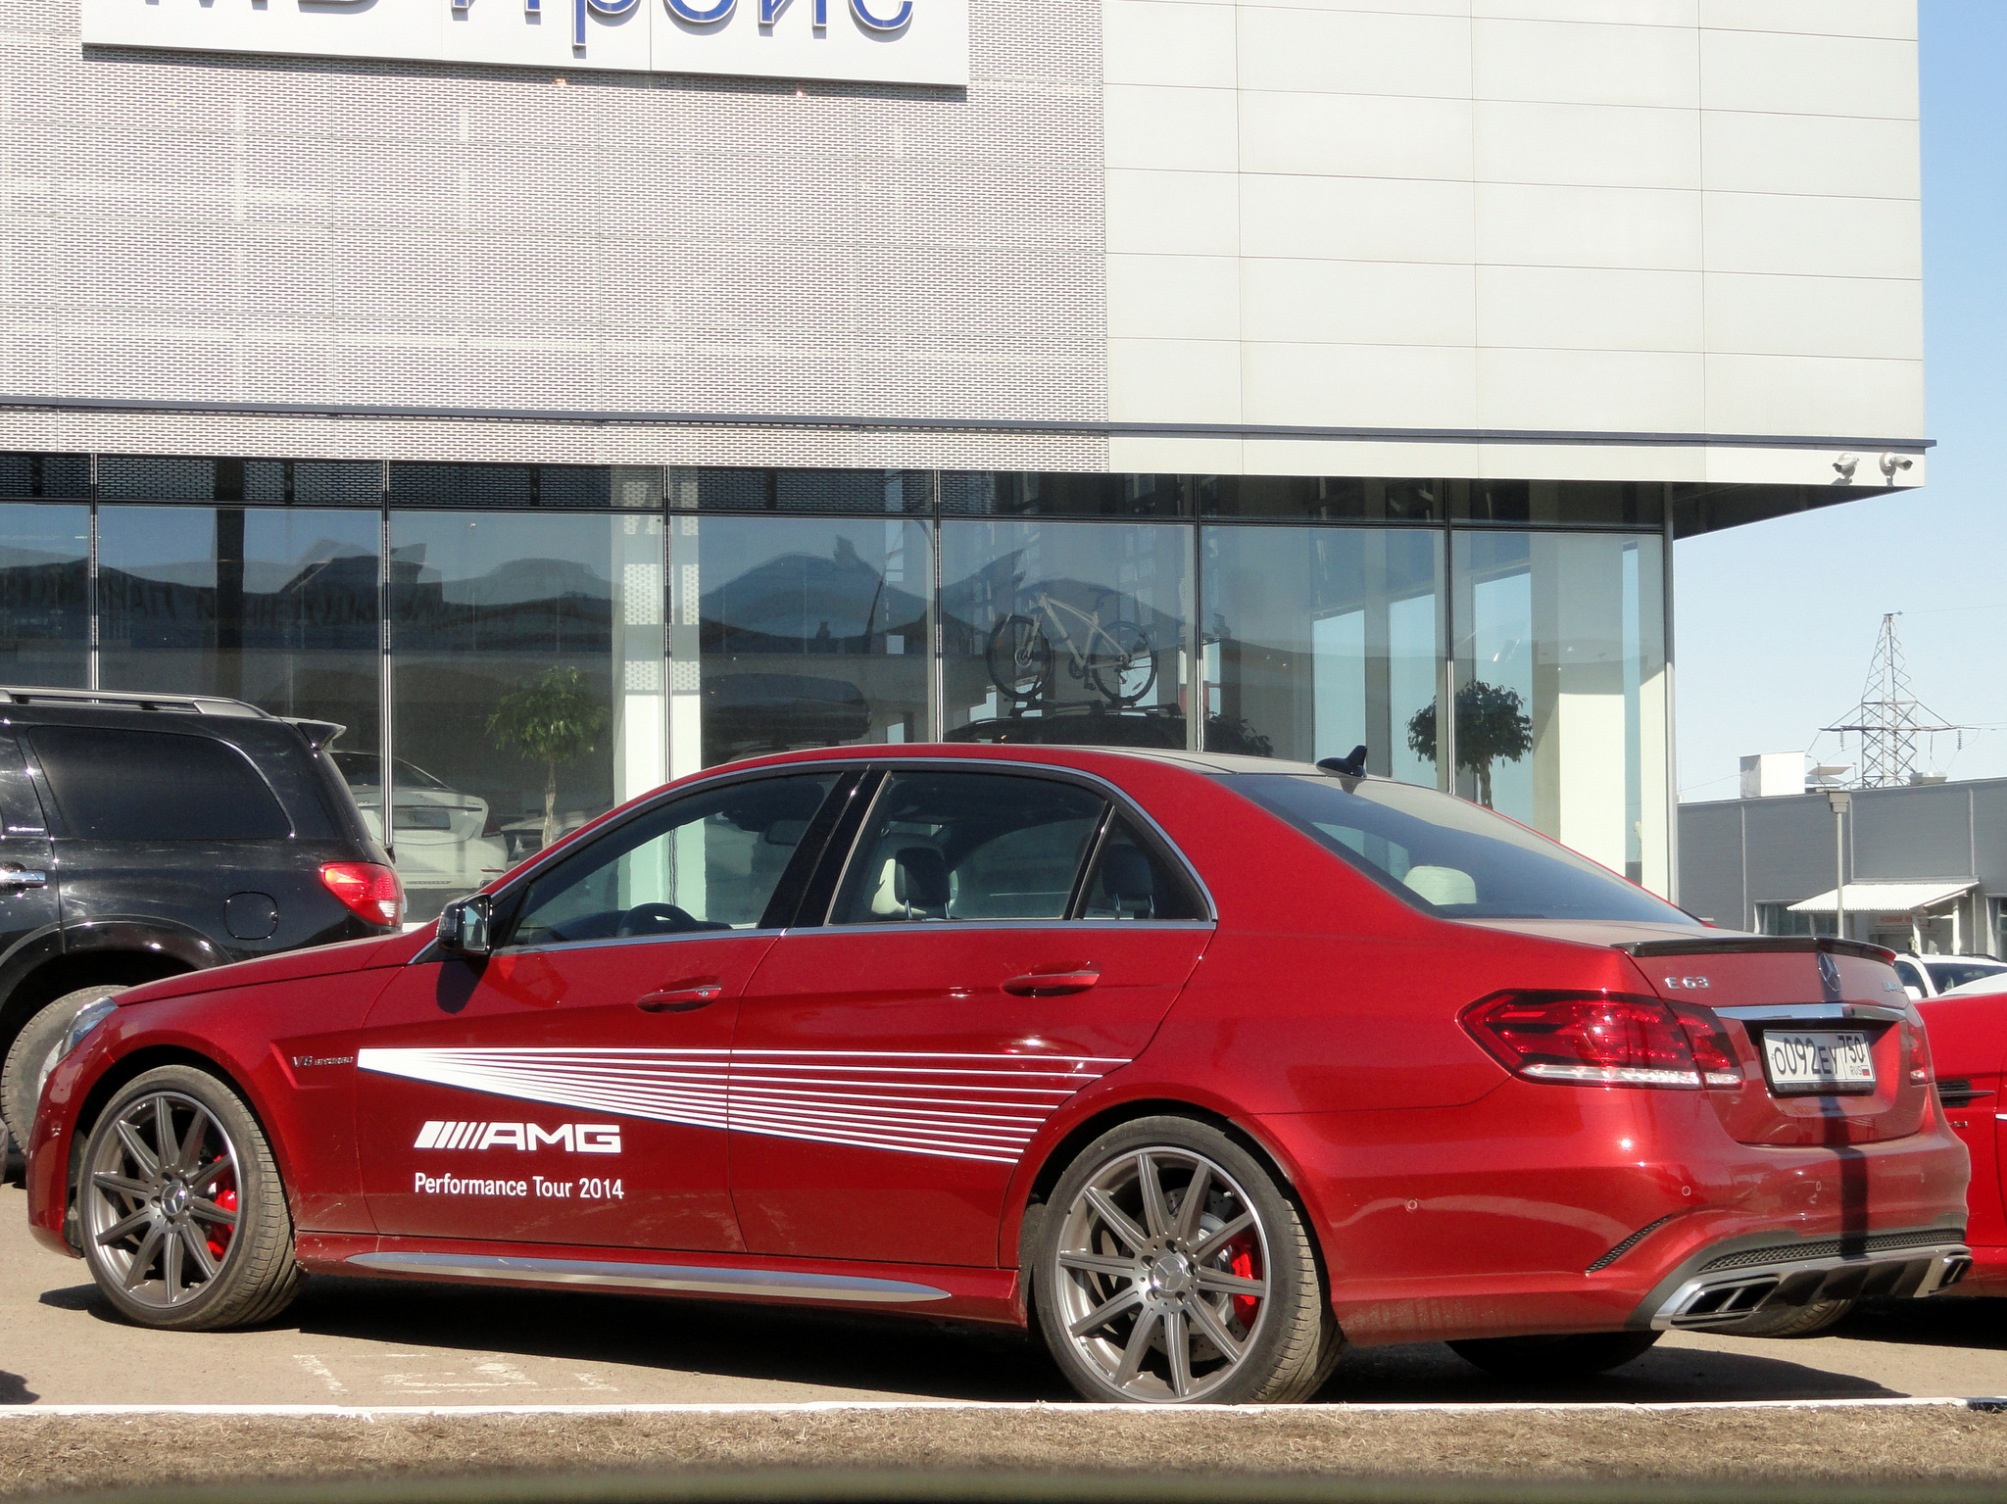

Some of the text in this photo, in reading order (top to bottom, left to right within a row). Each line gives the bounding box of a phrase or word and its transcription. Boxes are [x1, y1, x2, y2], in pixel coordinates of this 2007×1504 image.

[477, 1121, 622, 1153] AMG
[414, 1172, 624, 1199] Performance Tour 2014
